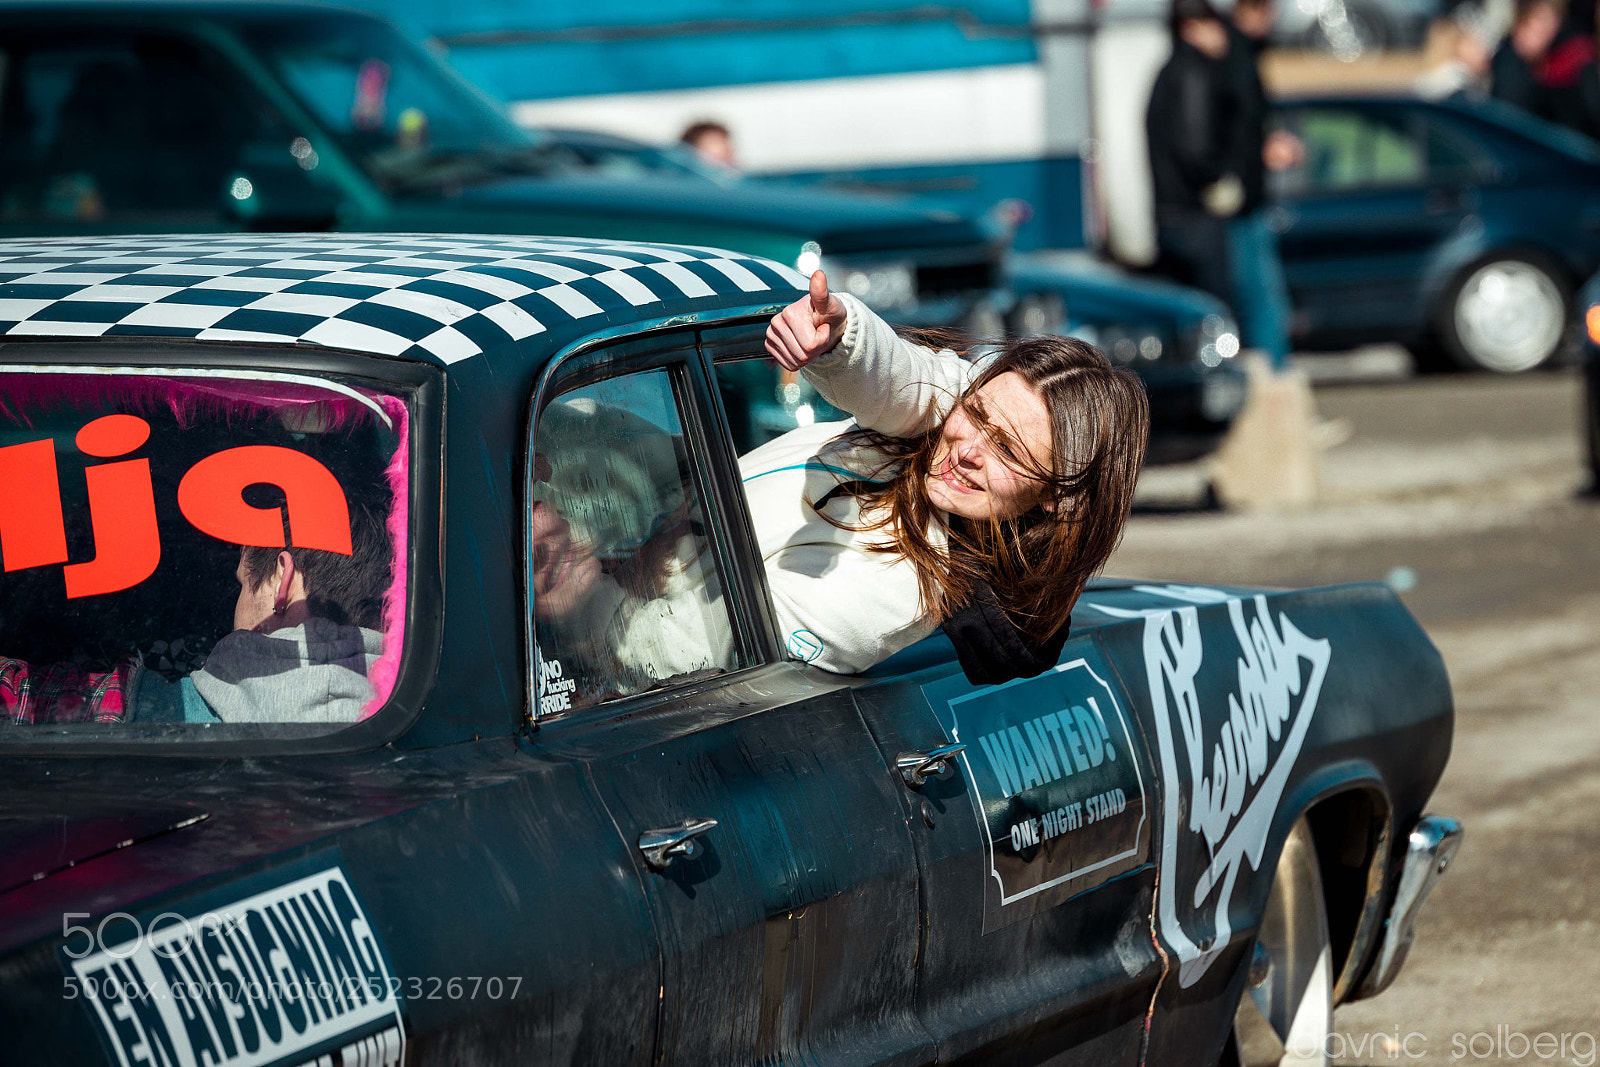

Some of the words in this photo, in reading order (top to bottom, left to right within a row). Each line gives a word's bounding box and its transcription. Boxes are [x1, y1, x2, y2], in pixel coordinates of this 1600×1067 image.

[544, 660, 562, 679] NO
[547, 679, 576, 693] fucking
[978, 697, 1117, 798] WANTED!
[1011, 822, 1040, 852] ONE
[1042, 806, 1083, 839] NIGHT
[1087, 788, 1127, 824] STAND
